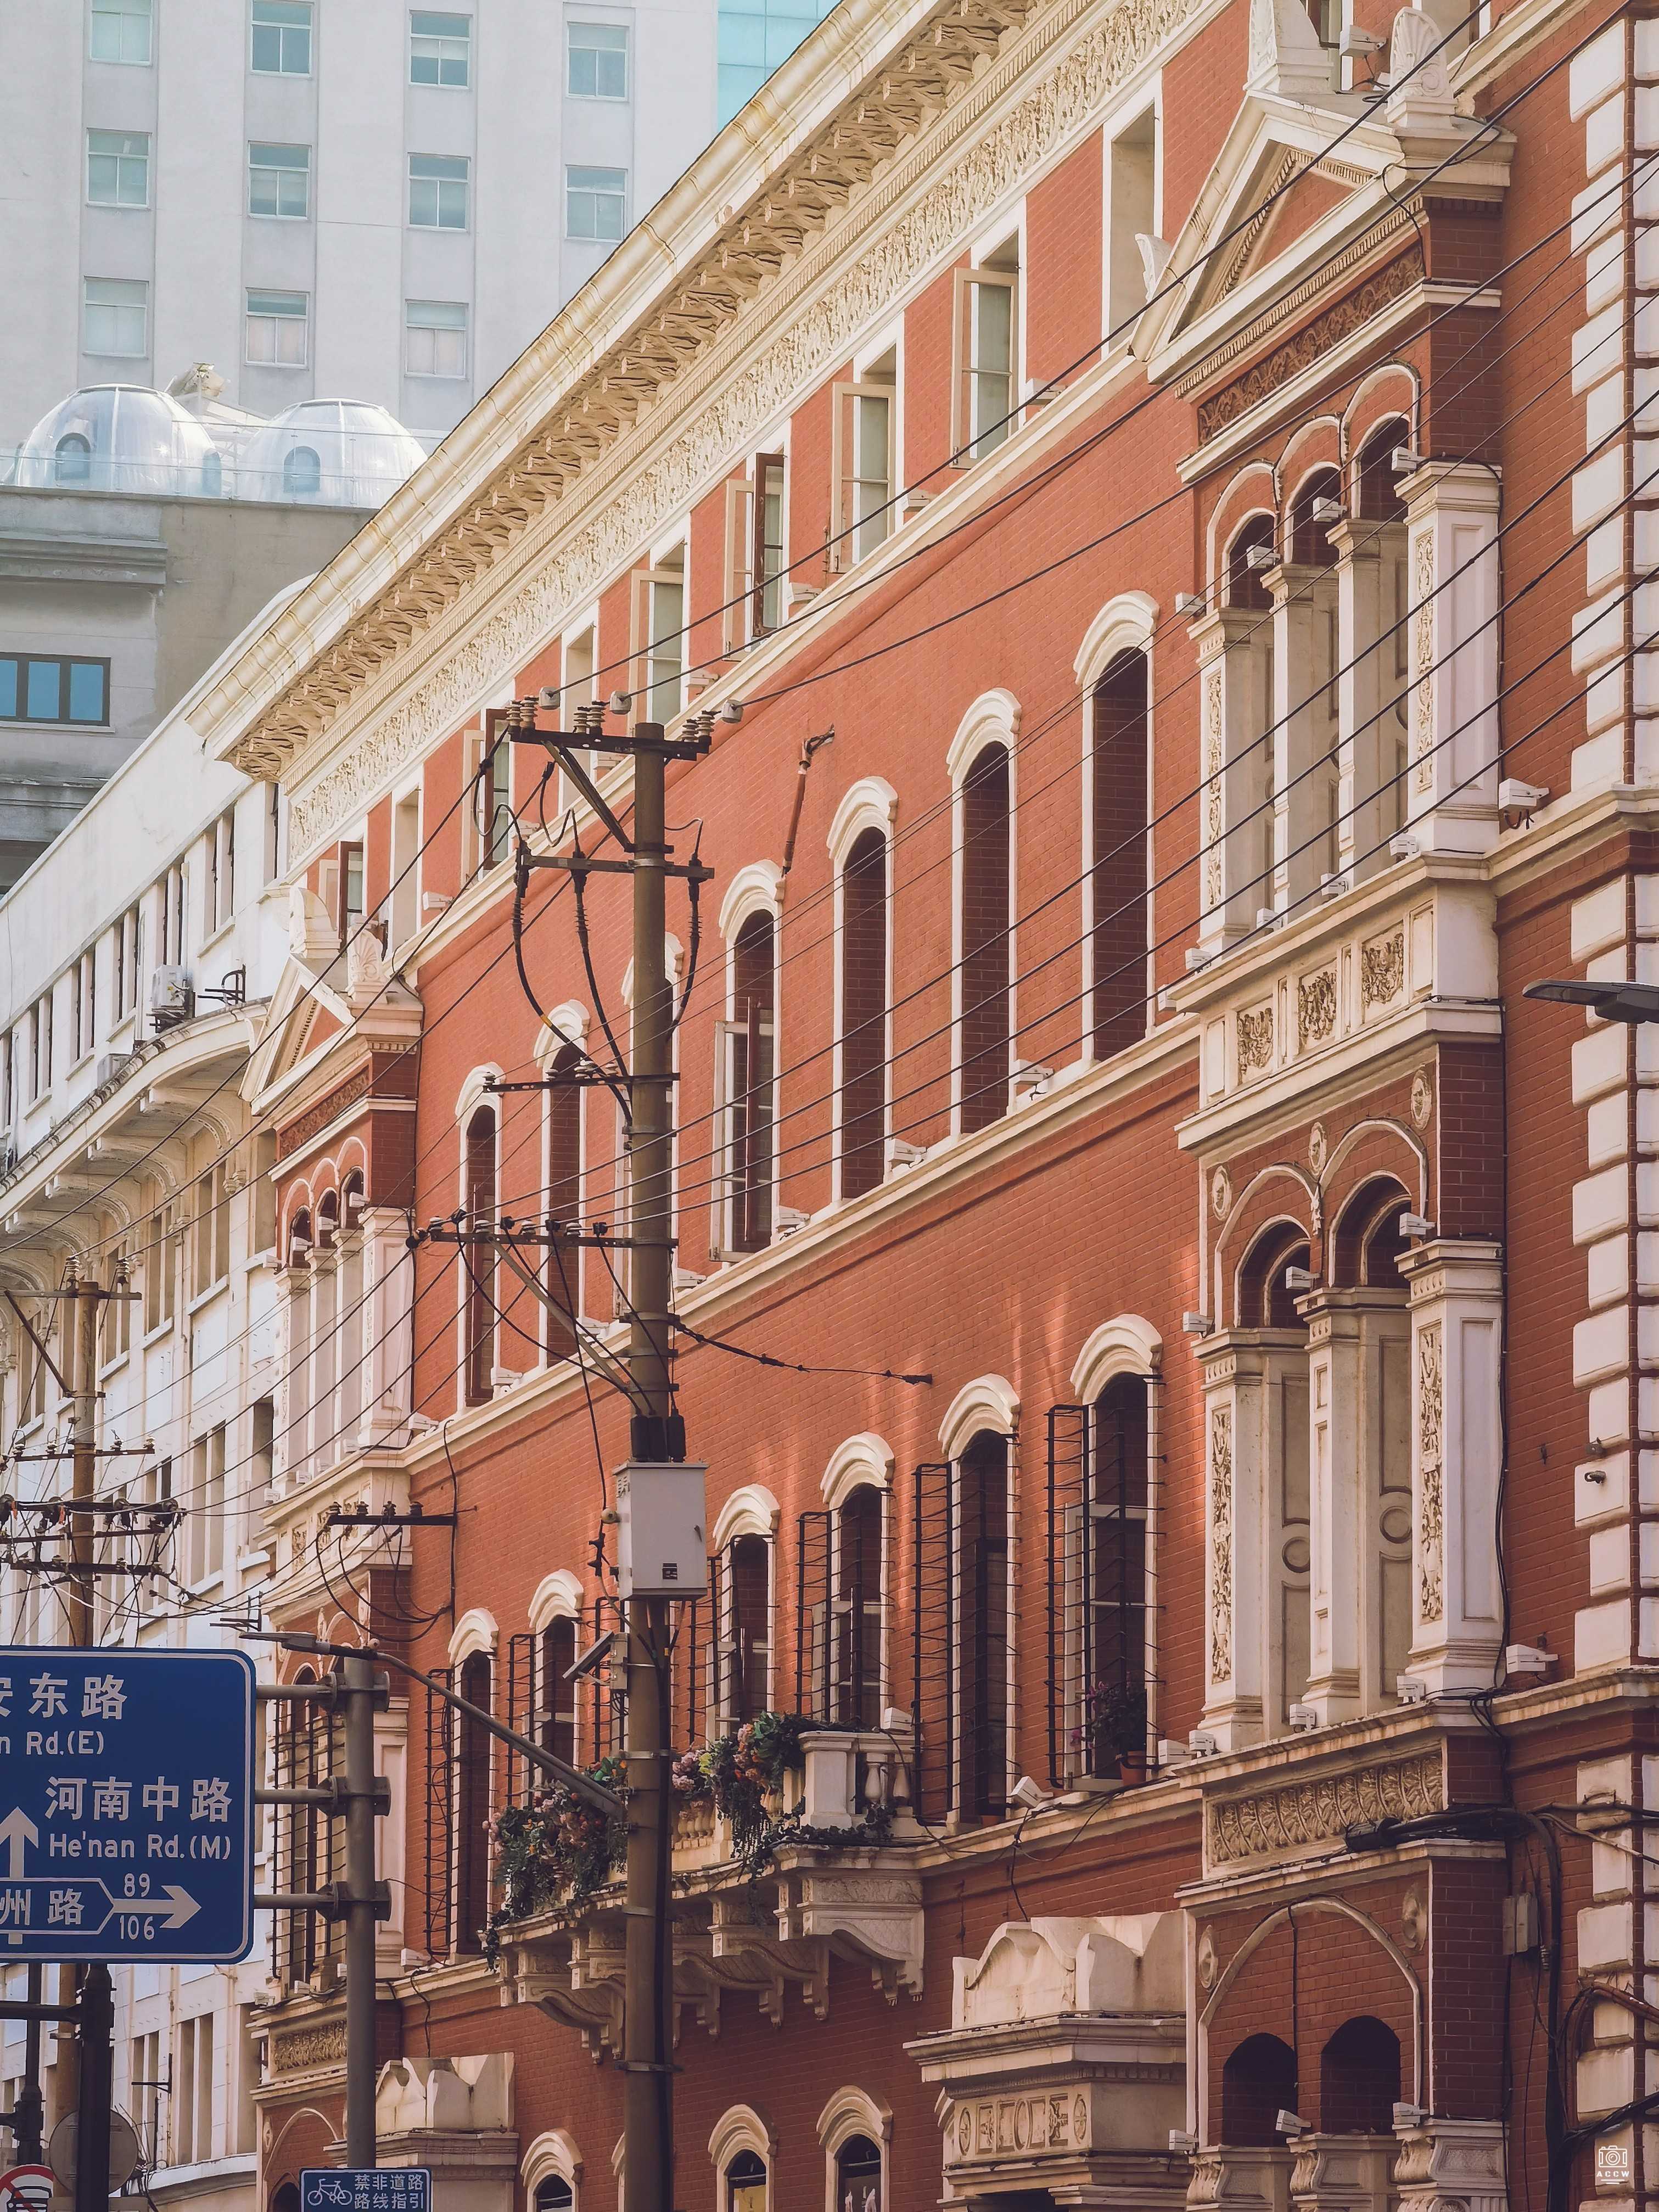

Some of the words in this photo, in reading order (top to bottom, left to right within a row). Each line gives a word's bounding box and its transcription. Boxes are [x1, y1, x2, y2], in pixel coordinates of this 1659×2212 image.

[26, 1731, 104, 1755] Rd.(E)
[45, 1776, 233, 1822] 河南中路
[50, 1831, 134, 1857] He'nan
[147, 1834, 231, 1860] Rd.(M)
[124, 1873, 150, 1897] 89
[120, 1914, 154, 1940] 106
[354, 2174, 424, 2191] 禁非道路
[354, 2192, 424, 2209] 路线指引
